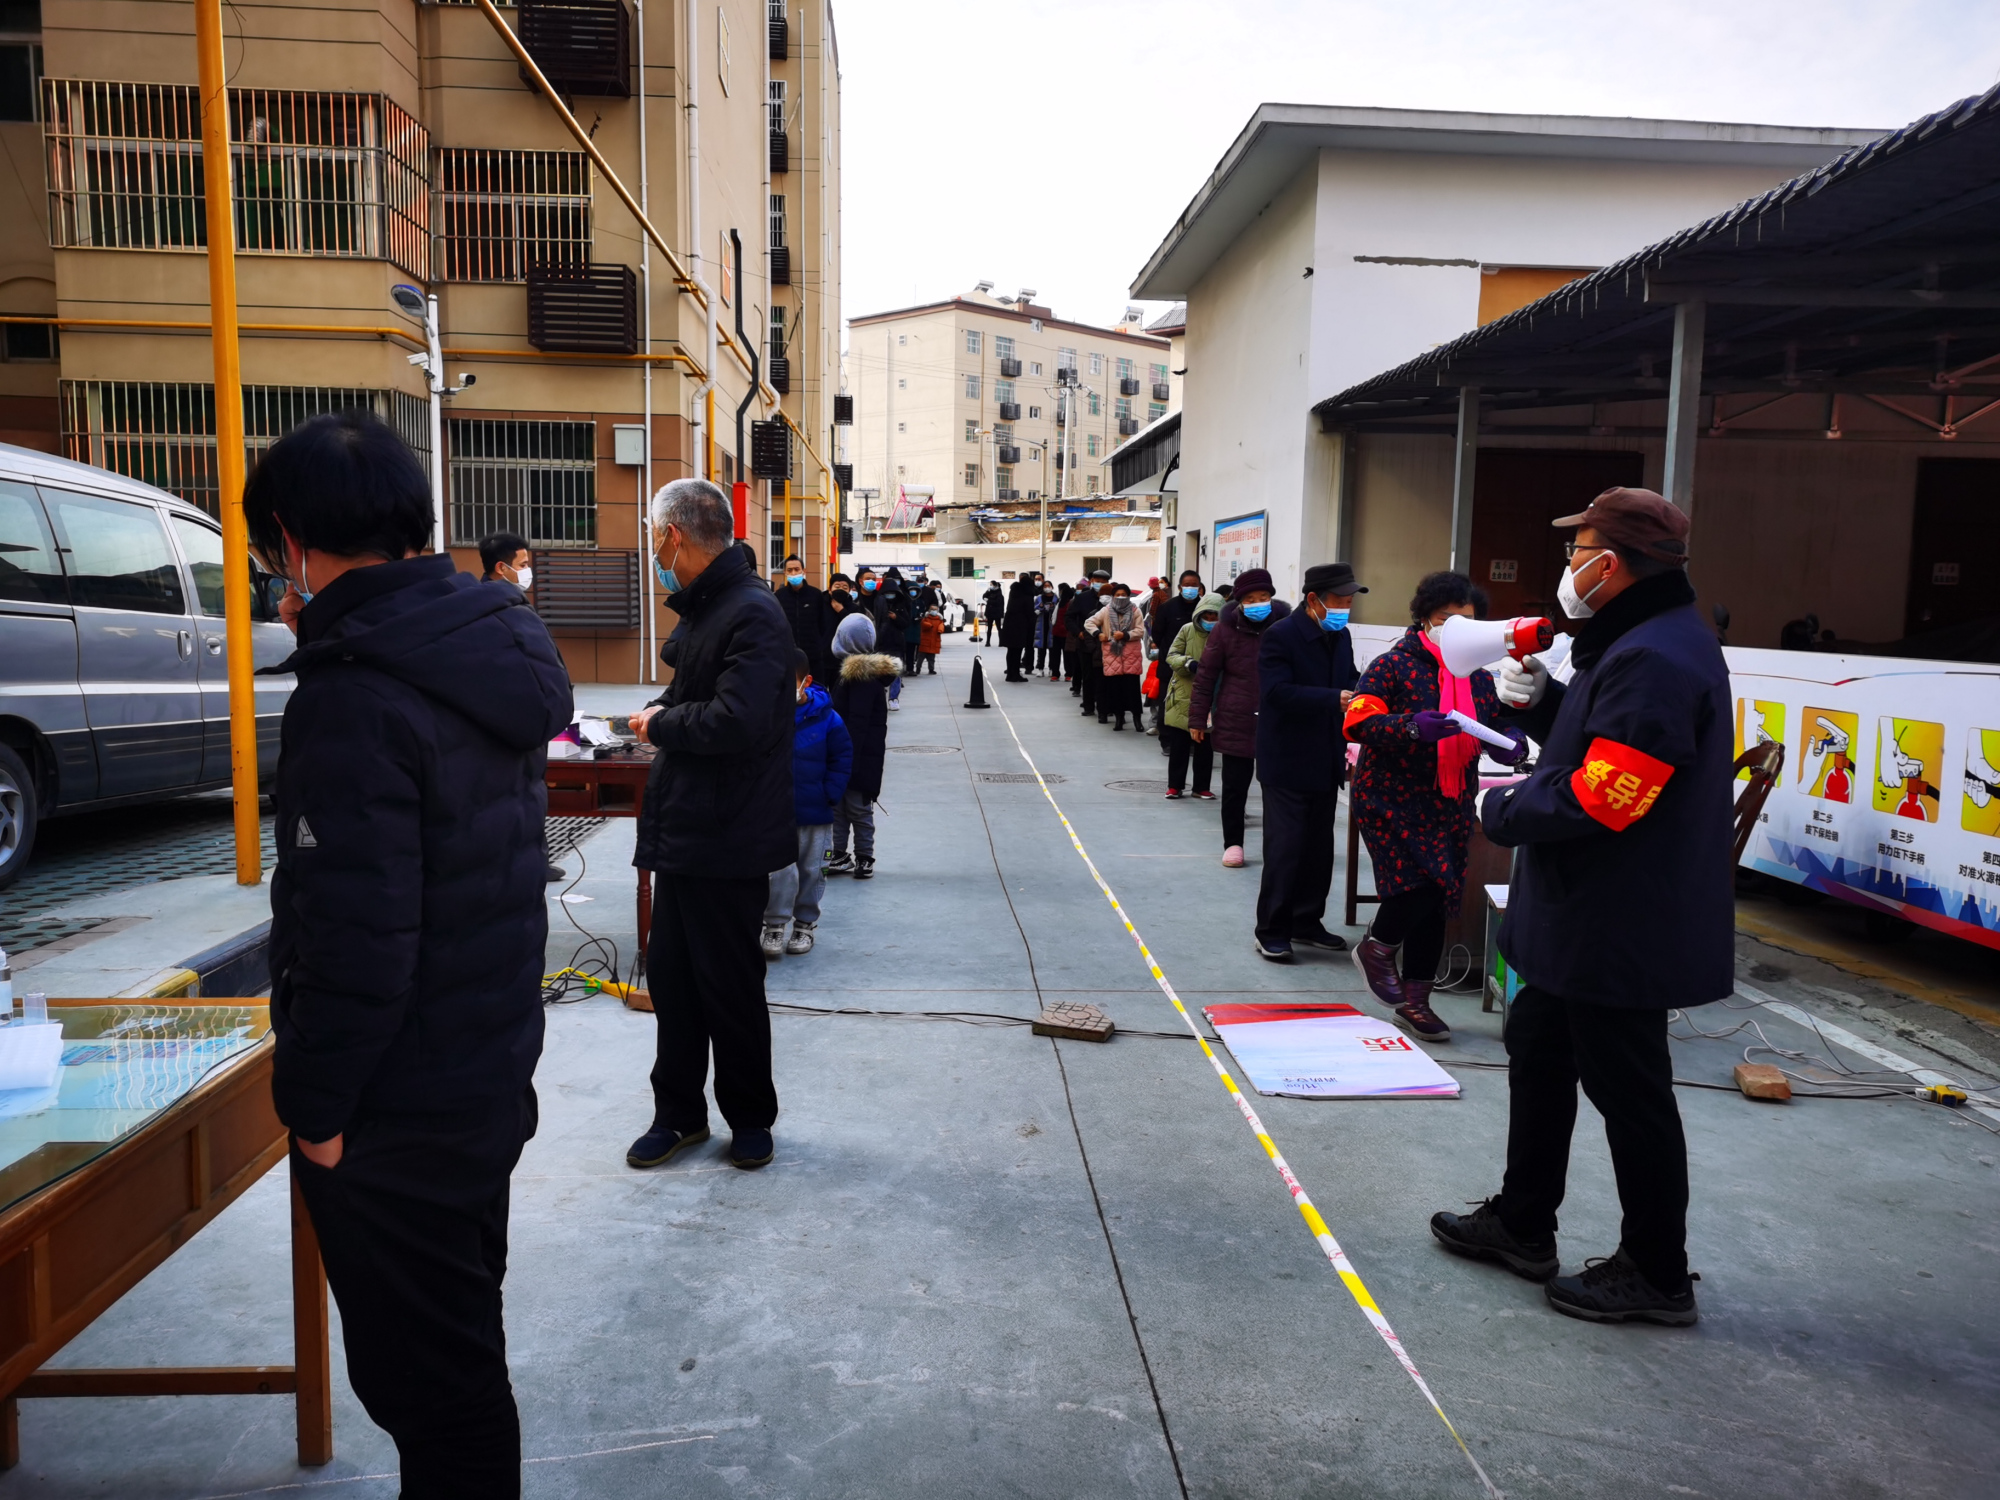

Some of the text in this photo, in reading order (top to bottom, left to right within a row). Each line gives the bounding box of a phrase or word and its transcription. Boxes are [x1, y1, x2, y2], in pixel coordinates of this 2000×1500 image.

[1812, 809, 1833, 824] 第二步
[1890, 828, 1914, 844] 第三步
[1877, 842, 1926, 866] 用力压下手柄
